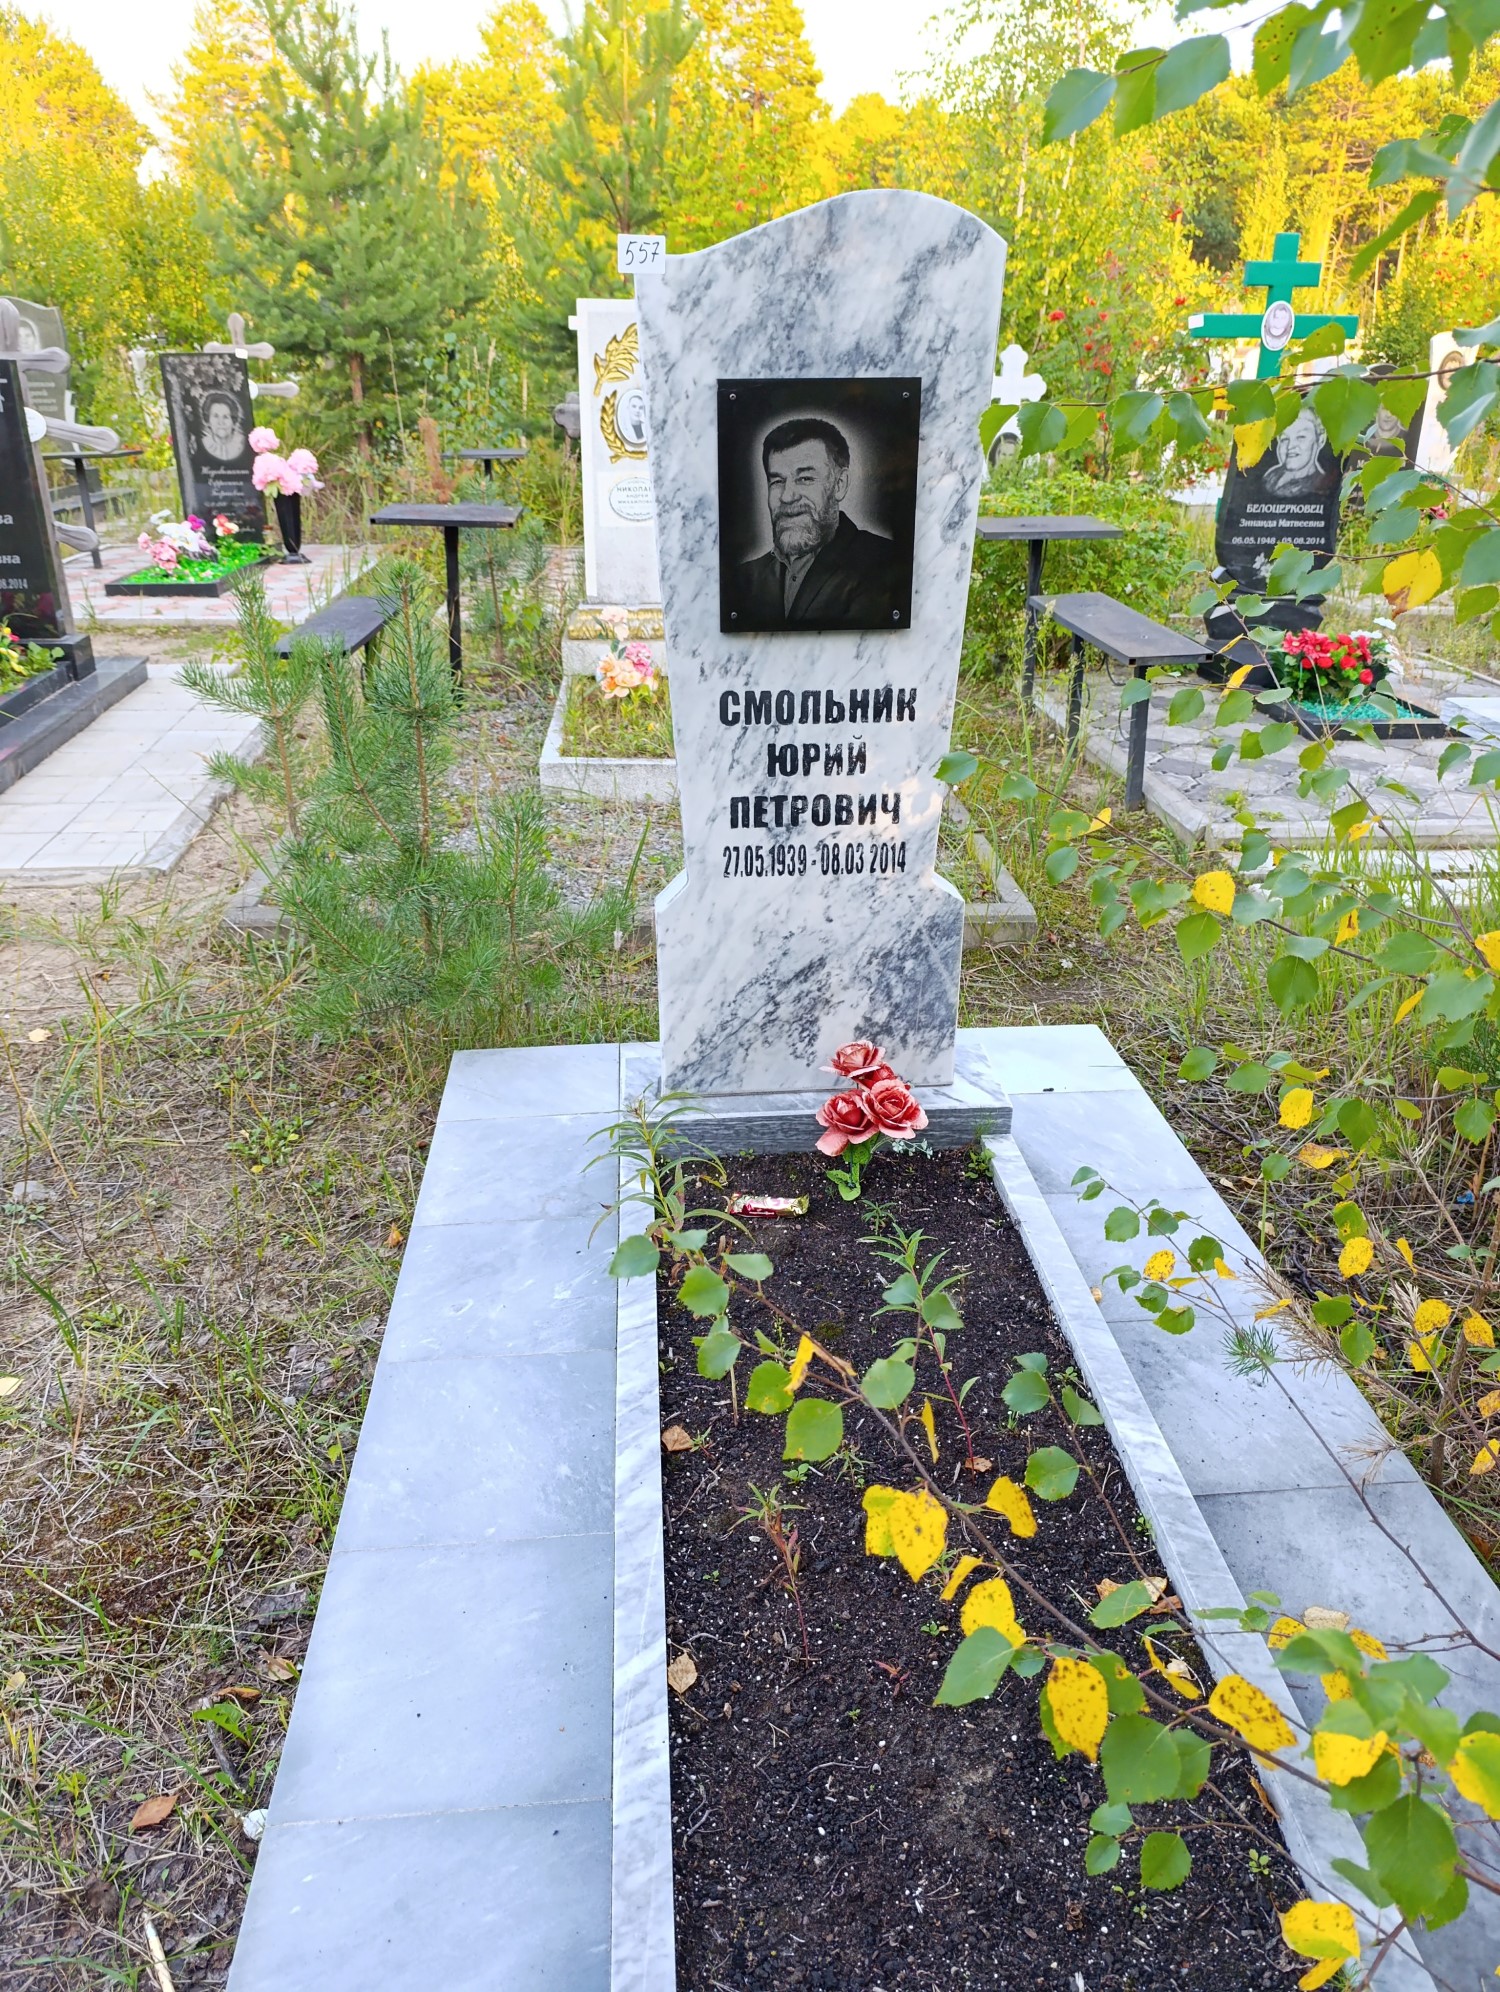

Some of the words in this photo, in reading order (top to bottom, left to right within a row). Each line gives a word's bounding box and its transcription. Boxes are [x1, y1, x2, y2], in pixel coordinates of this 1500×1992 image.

[625, 240, 660, 266] 557
[1246, 503, 1324, 515] БЕЛОЦЕРКОВЕЦ
[1239, 518, 1277, 528] Зинаида
[1278, 518, 1325, 528] Матвеевна
[1231, 536, 1276, 545] 06.05.1948
[1281, 536, 1325, 545] 0508.2014
[0, 578, 29, 590] 8.2014
[719, 687, 917, 727] СМОЛЬНИК
[766, 734, 868, 778] ЮРИЙ
[729, 792, 901, 829] ПЕТРОВИЧ
[722, 843, 807, 878] 27.05.1939
[820, 840, 907, 876] 08.032014
